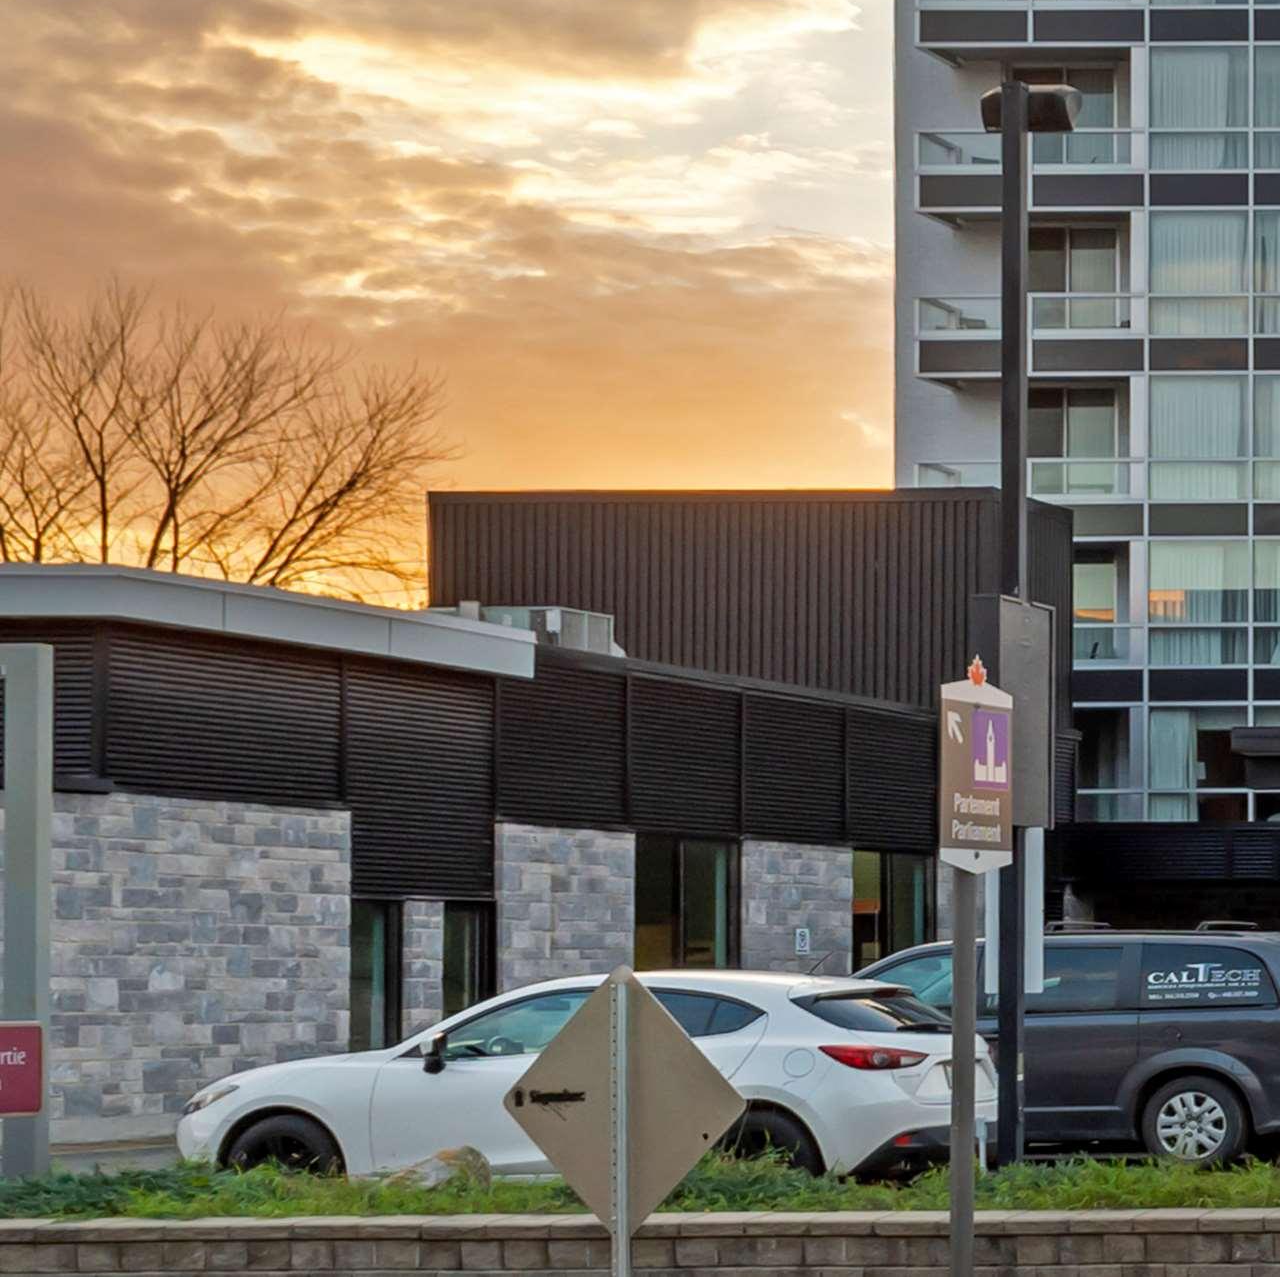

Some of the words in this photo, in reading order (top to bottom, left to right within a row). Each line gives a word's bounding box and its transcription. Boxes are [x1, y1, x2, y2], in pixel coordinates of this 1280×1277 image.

[954, 792, 1000, 817] Parlement
[952, 818, 1002, 843] Parliament
[0, 1046, 26, 1065] rtie
